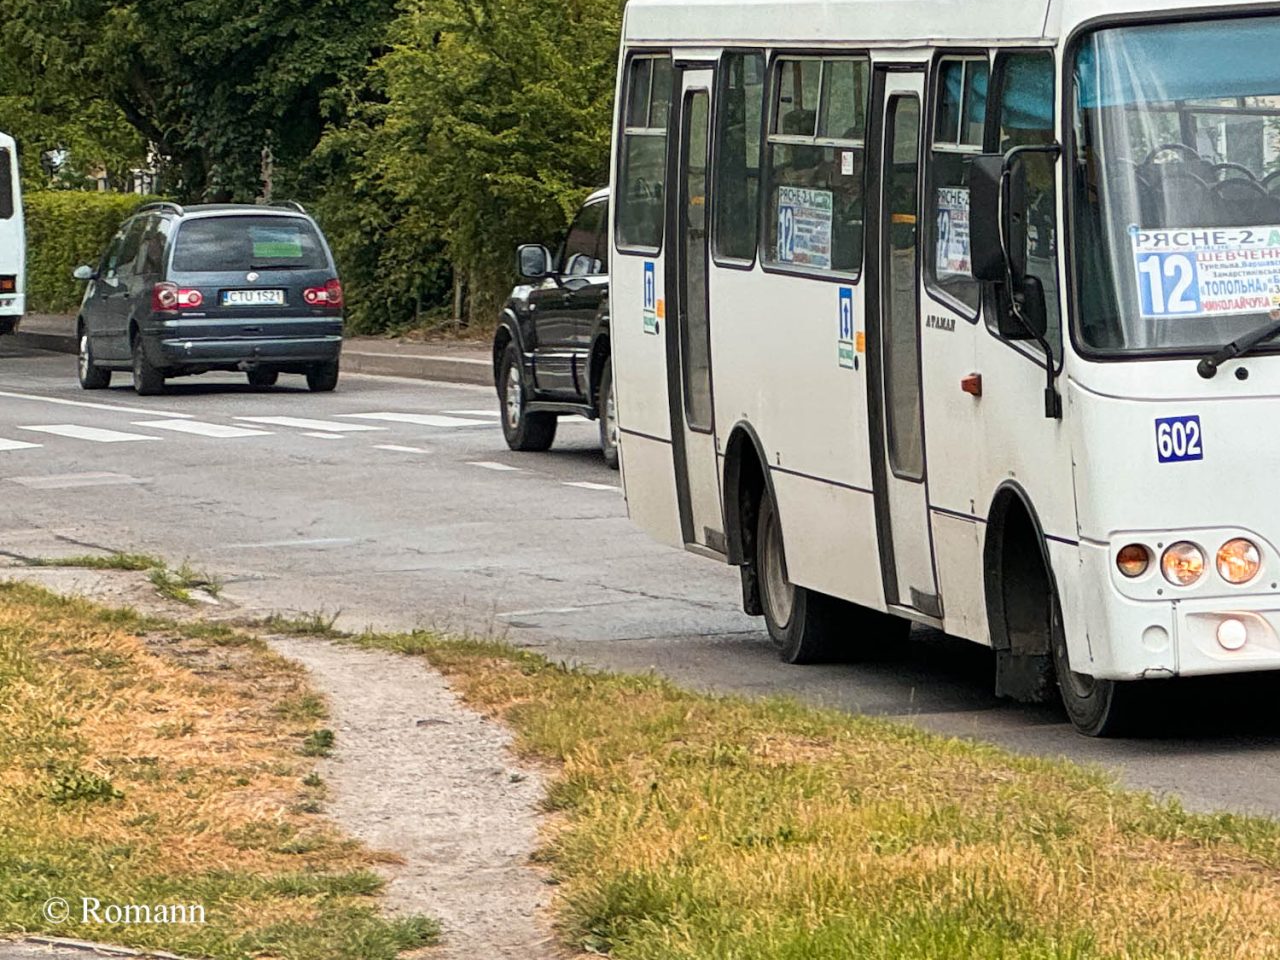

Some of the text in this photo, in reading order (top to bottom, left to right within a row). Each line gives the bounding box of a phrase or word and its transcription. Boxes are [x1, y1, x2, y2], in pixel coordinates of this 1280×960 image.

[780, 208, 793, 260] 12
[230, 292, 253, 302] CTU
[1139, 254, 1197, 313] 12
[1158, 421, 1201, 458] 602
